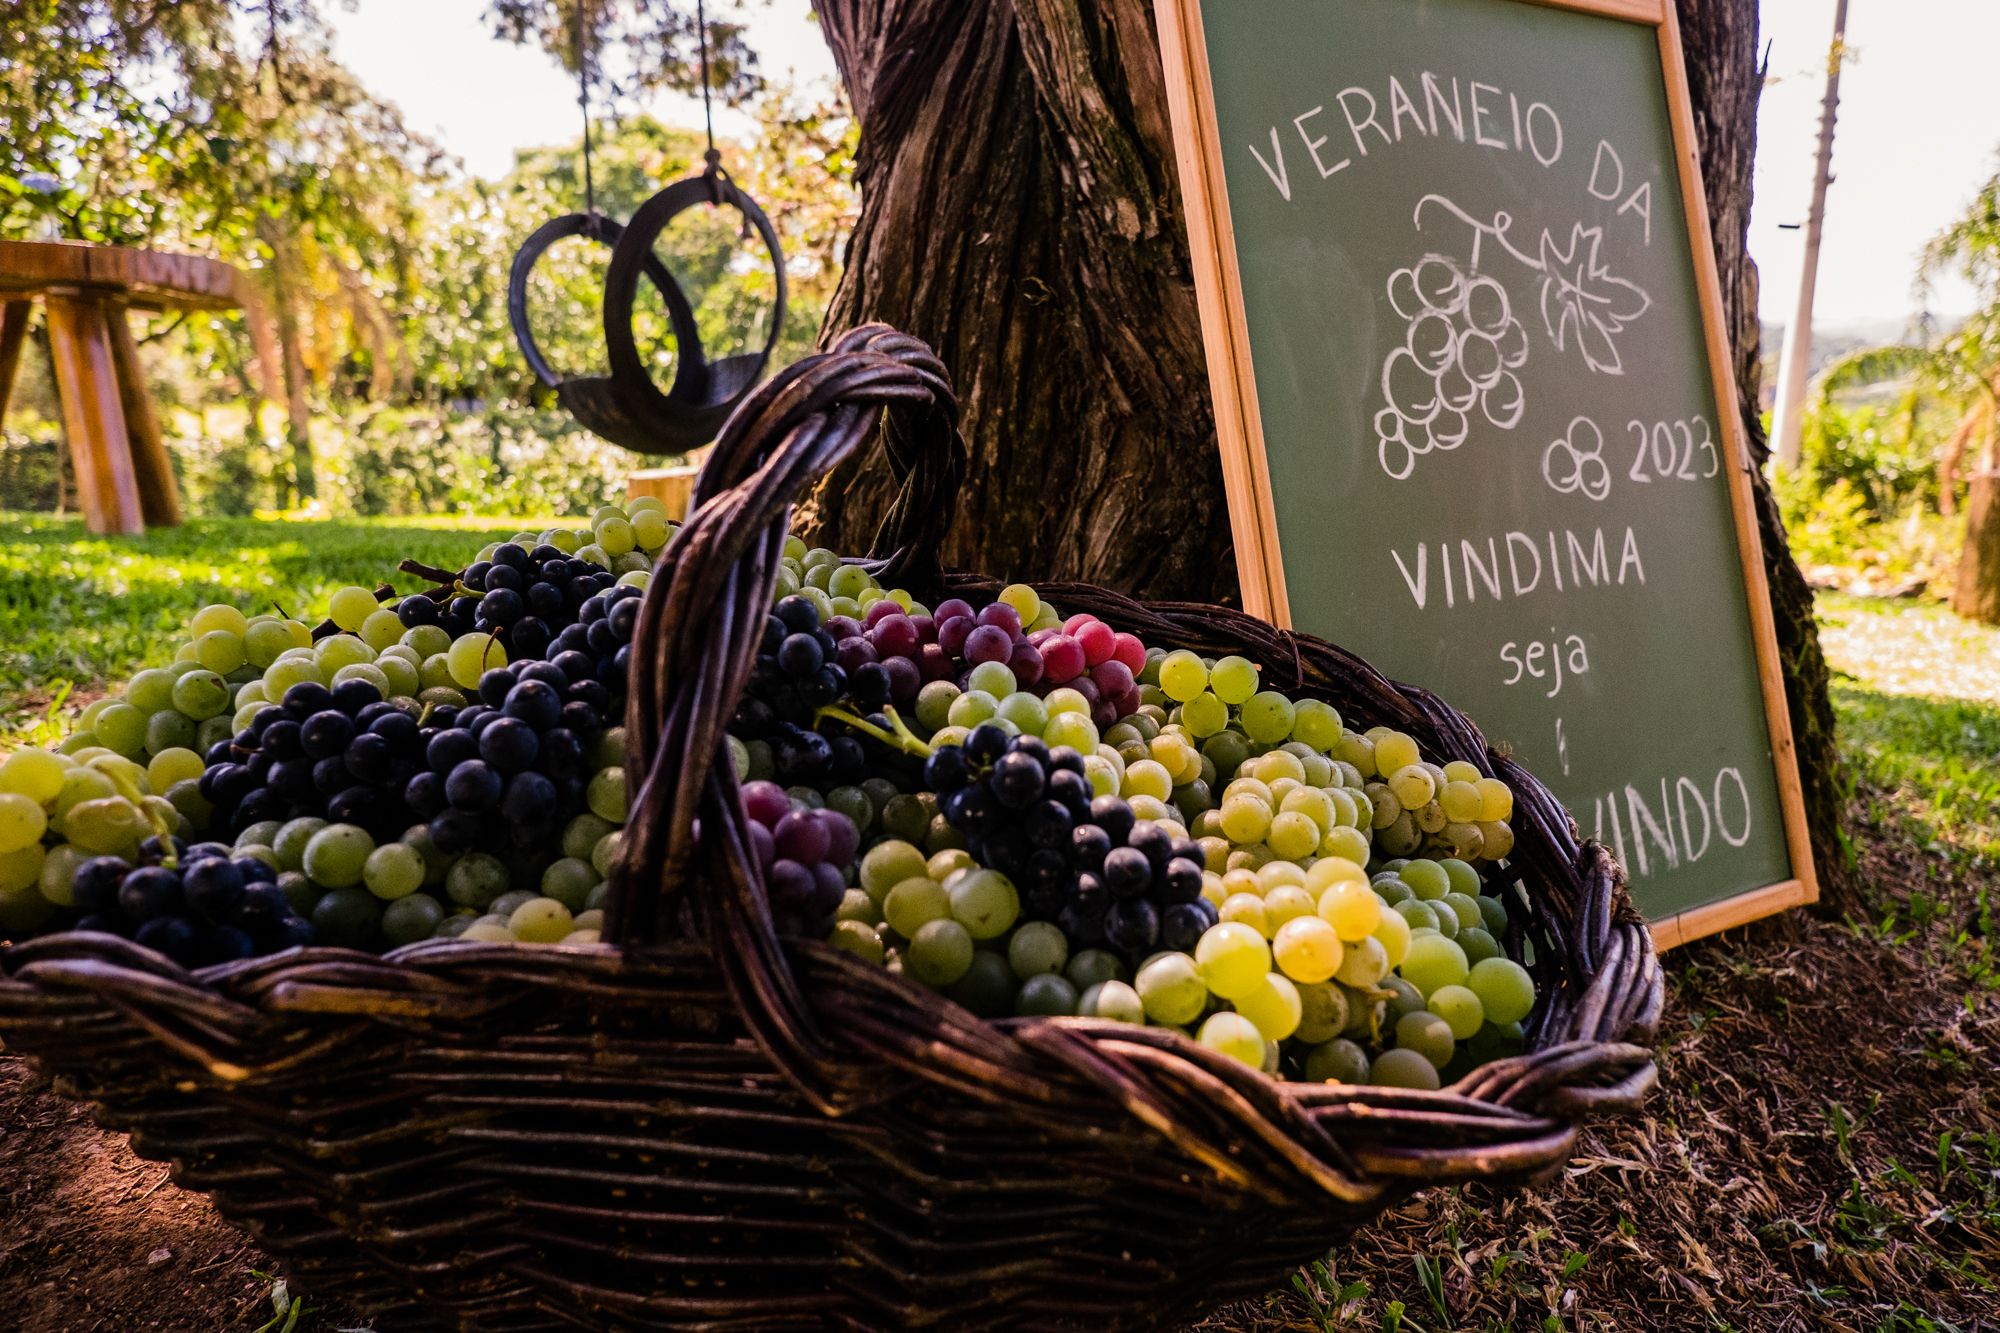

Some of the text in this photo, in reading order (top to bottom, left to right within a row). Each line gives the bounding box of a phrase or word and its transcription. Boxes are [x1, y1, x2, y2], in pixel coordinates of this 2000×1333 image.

[1247, 71, 1652, 246] VERANEIO DA
[1626, 415, 1720, 484] 2023
[1391, 526, 1646, 611] VINDIMA
[1500, 627, 1590, 699] seja
